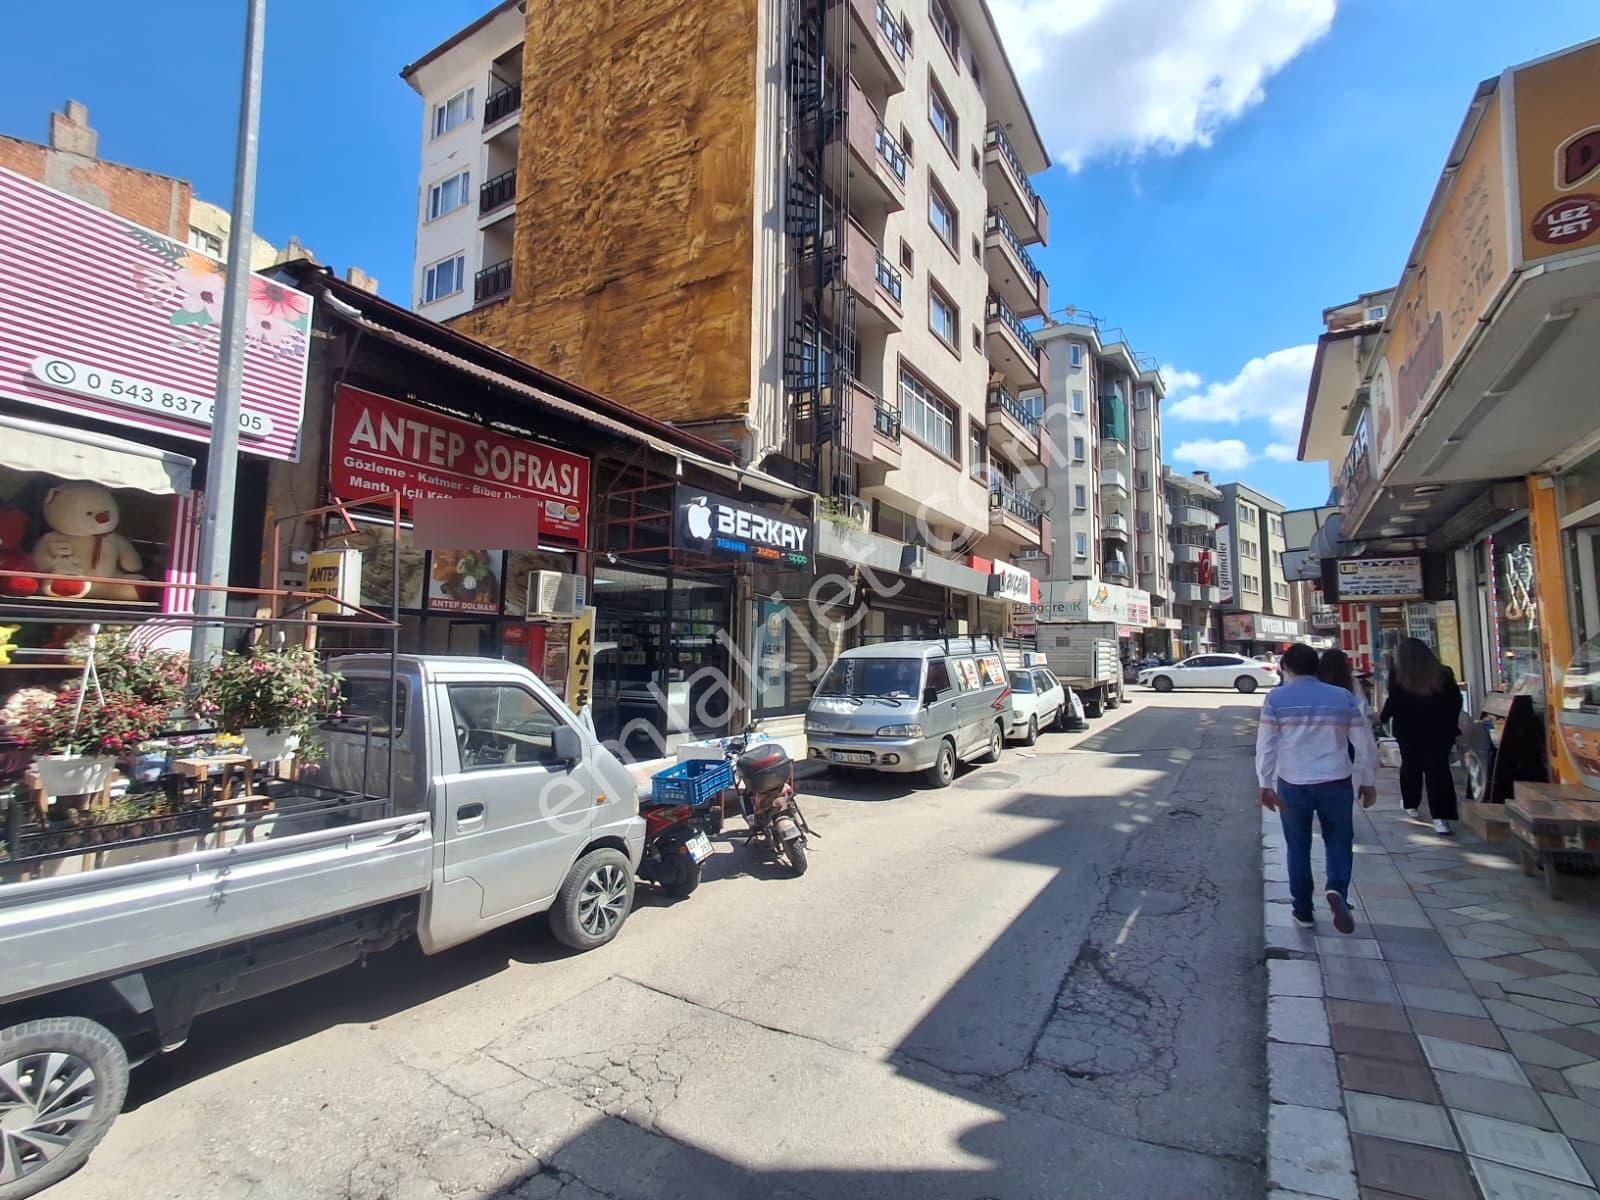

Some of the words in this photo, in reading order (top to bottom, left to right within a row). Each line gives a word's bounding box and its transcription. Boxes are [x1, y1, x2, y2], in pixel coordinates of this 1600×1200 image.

[1547, 205, 1590, 225] LEZ
[1547, 218, 1592, 239] ZET
[87, 373, 101, 390] 0
[110, 379, 153, 403] 543
[161, 392, 202, 414] 837
[350, 407, 465, 468] ANTEP
[473, 439, 579, 498] SOFRASI
[343, 456, 406, 479] Gözleme
[417, 471, 463, 491] Katmer
[472, 484, 502, 499] Biber
[349, 475, 391, 494] Mantı
[402, 486, 423, 500] İçli
[718, 504, 808, 551] BERKAY
[310, 566, 339, 582] ANTEP
[431, 599, 460, 609] ANTEP
[461, 601, 496, 612] DOLMASI
